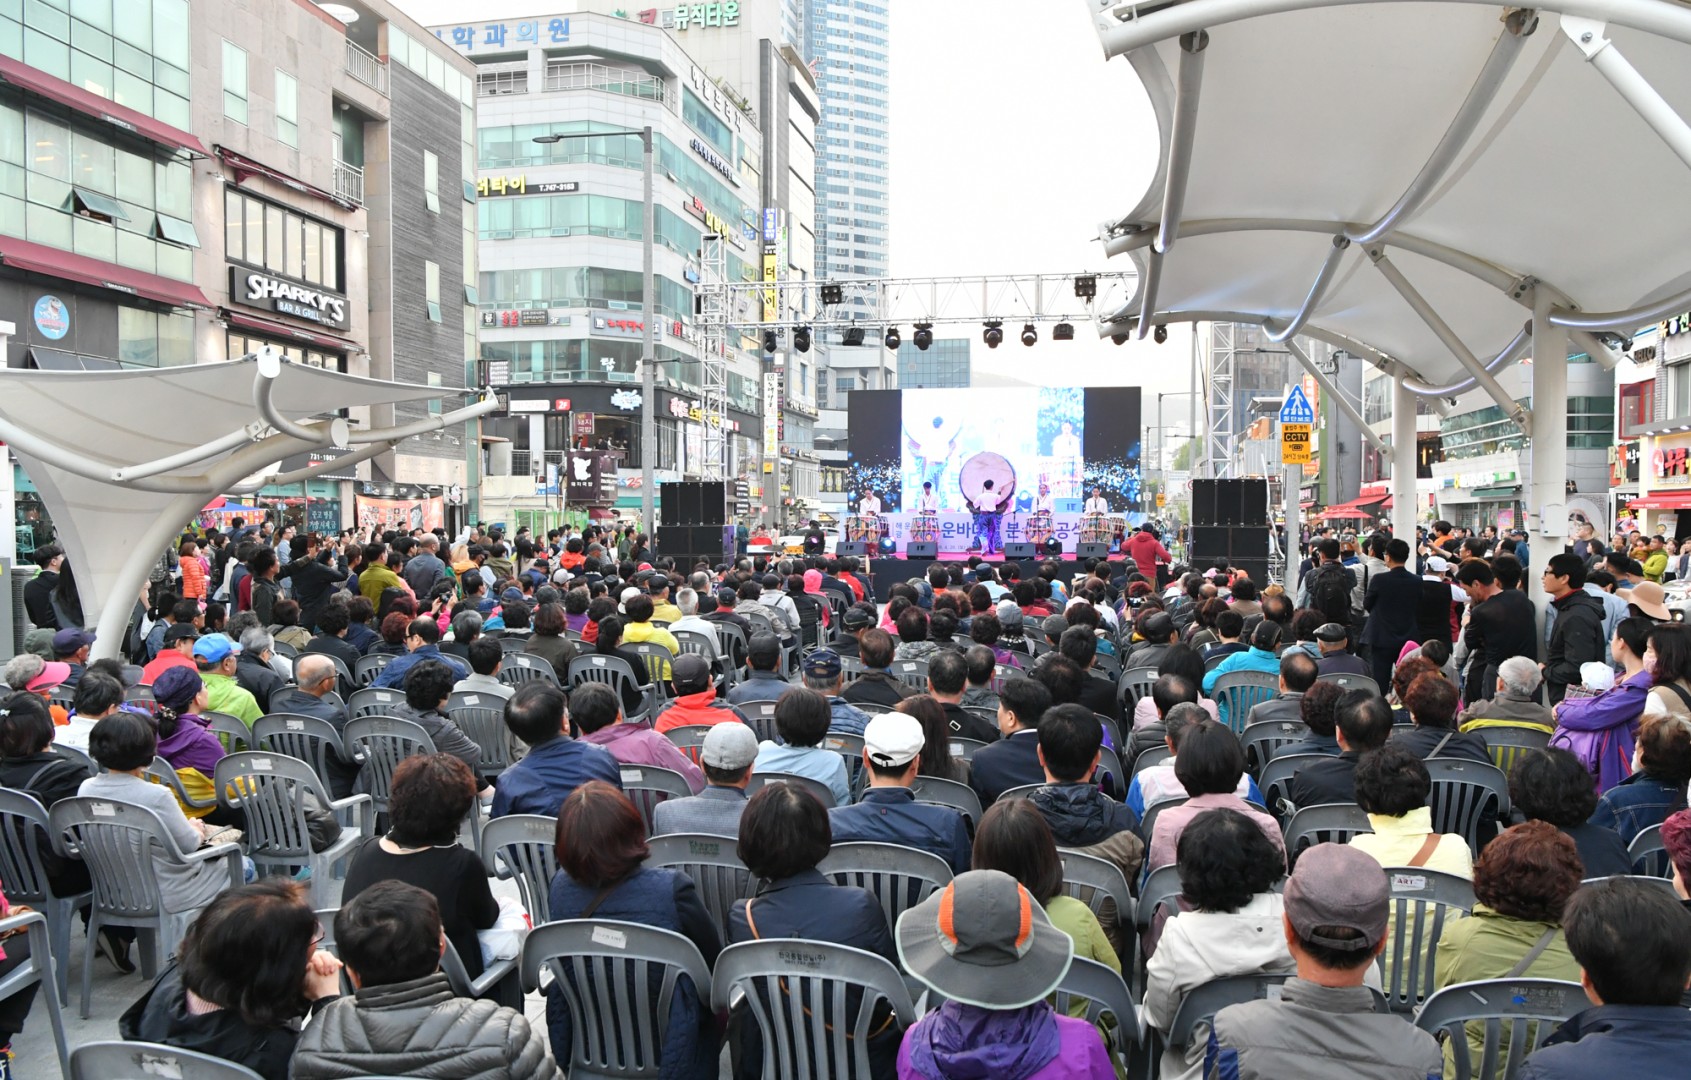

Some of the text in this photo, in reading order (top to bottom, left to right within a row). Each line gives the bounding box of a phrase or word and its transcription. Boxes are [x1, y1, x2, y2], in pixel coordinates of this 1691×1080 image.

[674, 0, 740, 31] 뮤직타운
[435, 17, 570, 51] 학과의원
[247, 275, 345, 322] SHARKY'S
[279, 302, 293, 313] BAR
[302, 308, 320, 321] GRILL
[558, 400, 568, 410] 2F
